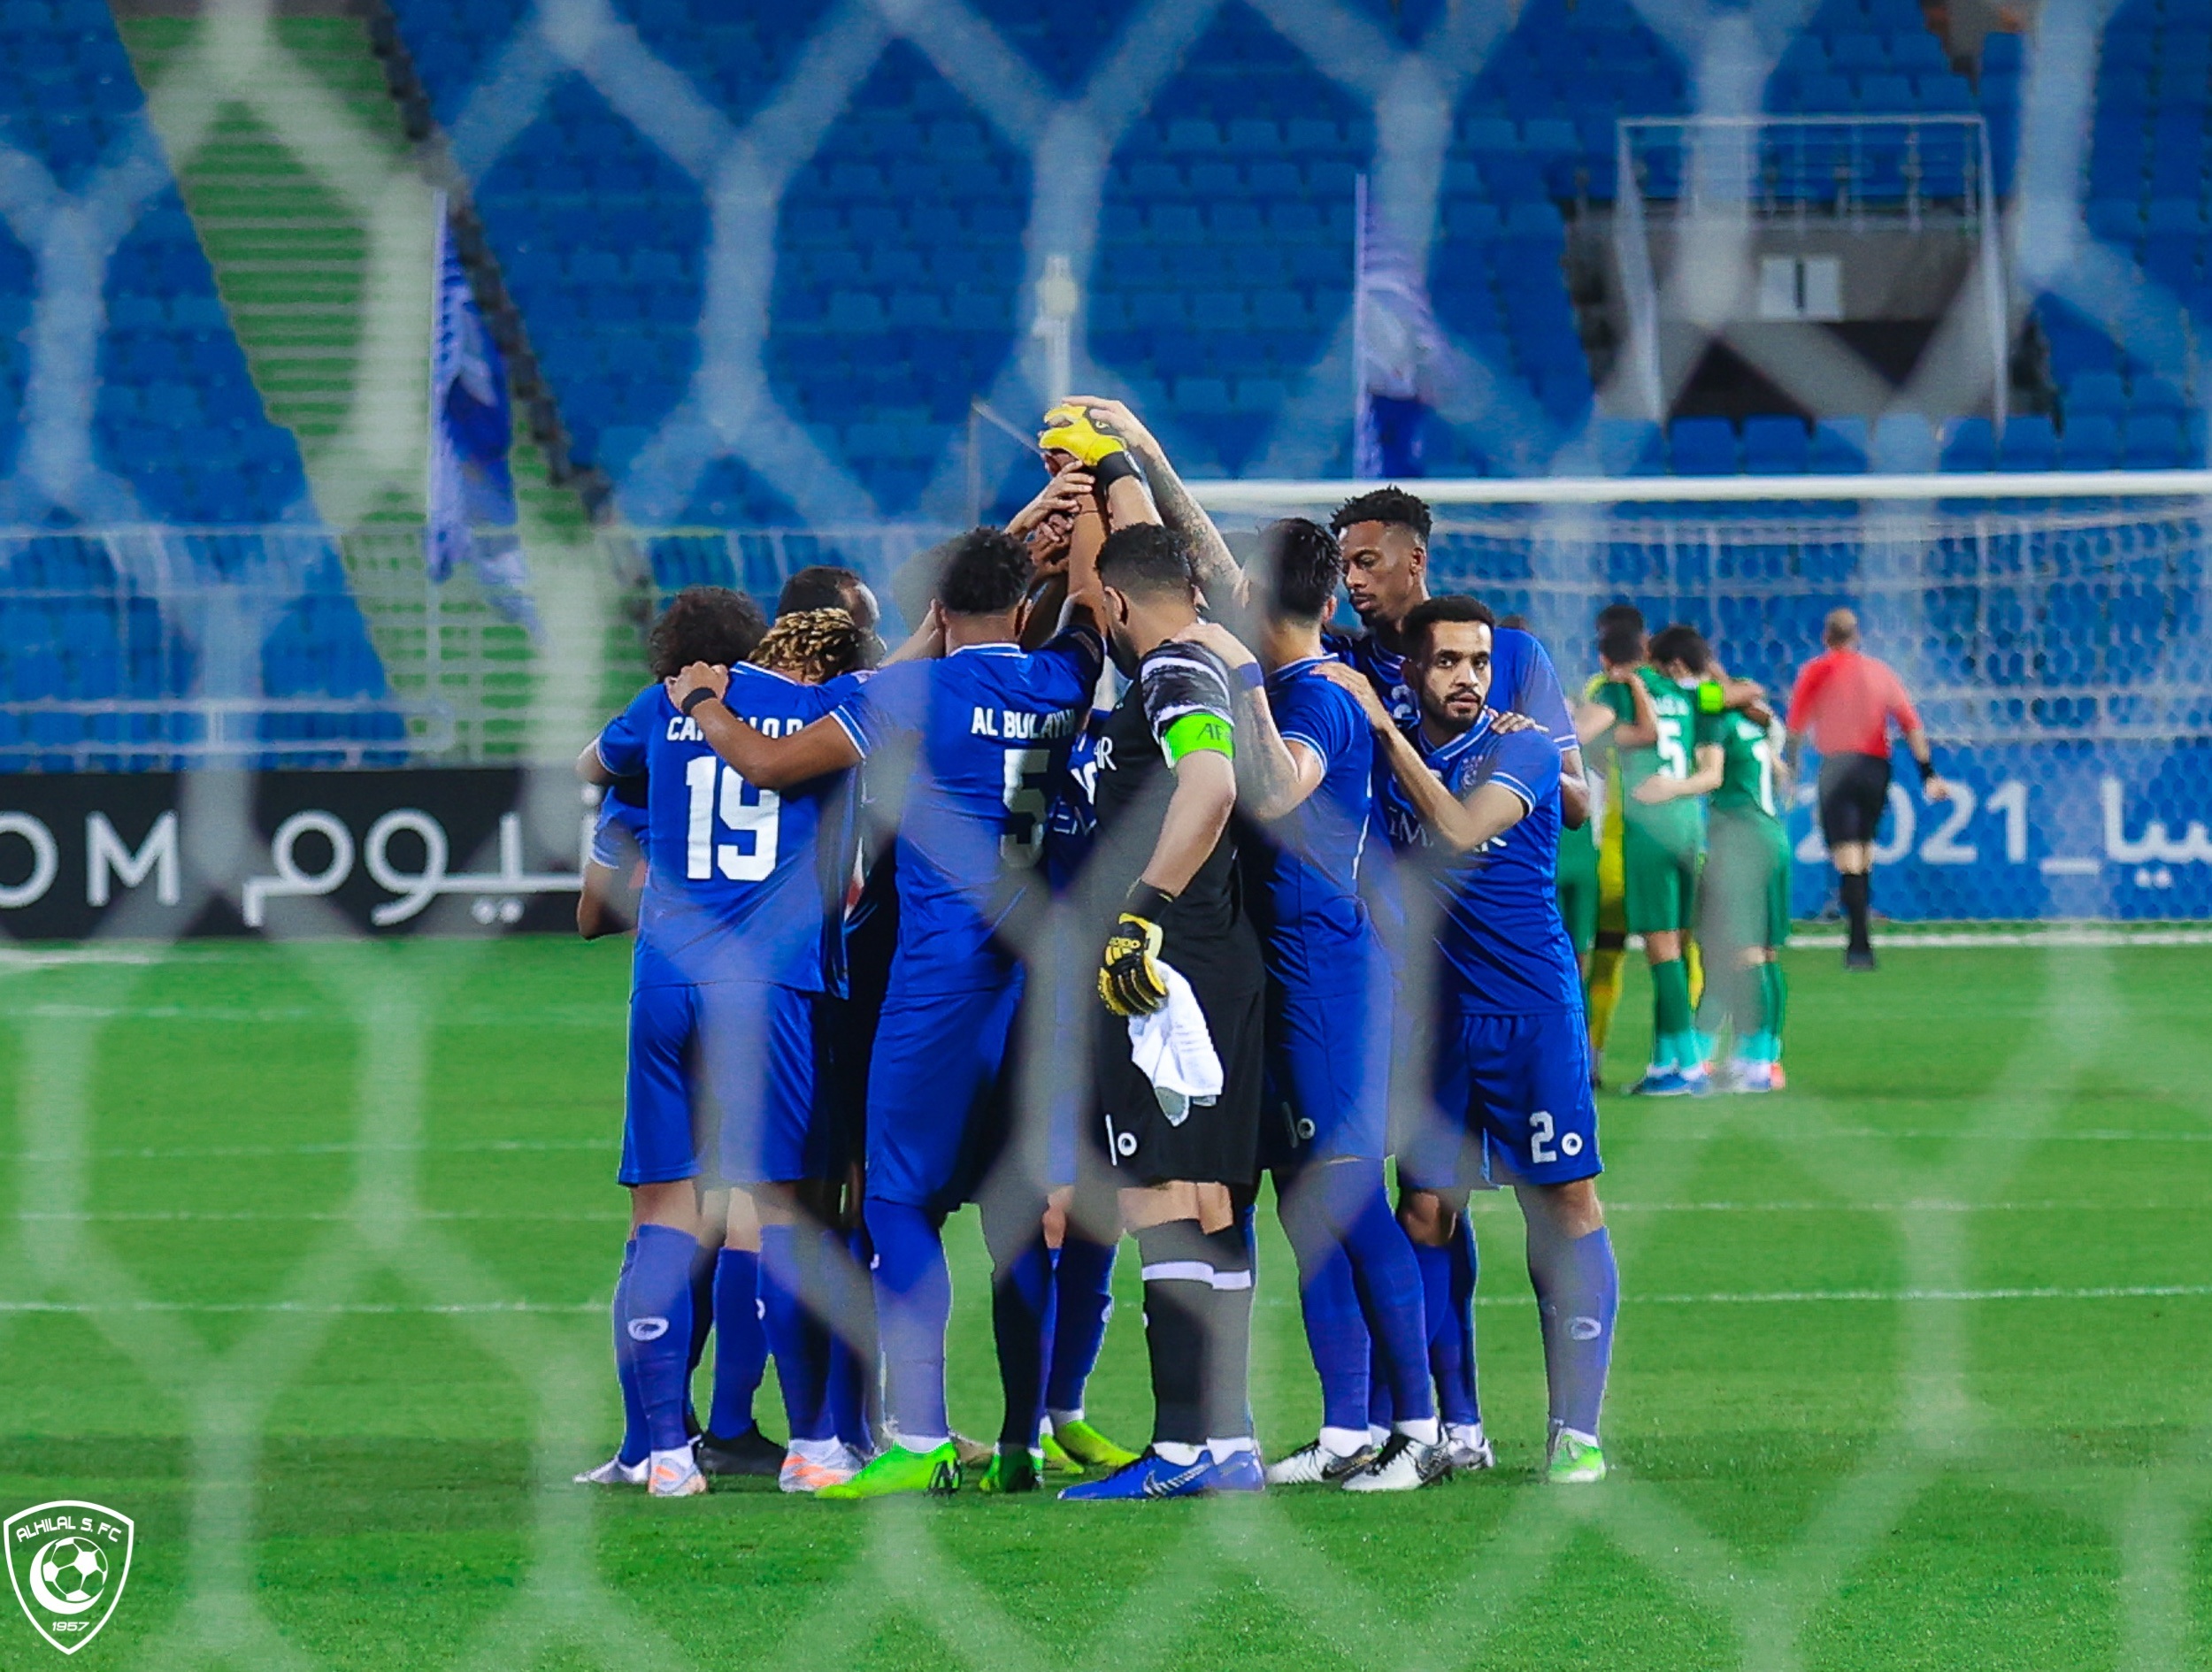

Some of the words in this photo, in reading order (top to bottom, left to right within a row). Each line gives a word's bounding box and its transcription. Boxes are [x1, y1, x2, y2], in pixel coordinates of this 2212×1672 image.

[971, 706, 999, 737] AL
[686, 755, 780, 882] 19
[1000, 748, 1051, 867] 5
